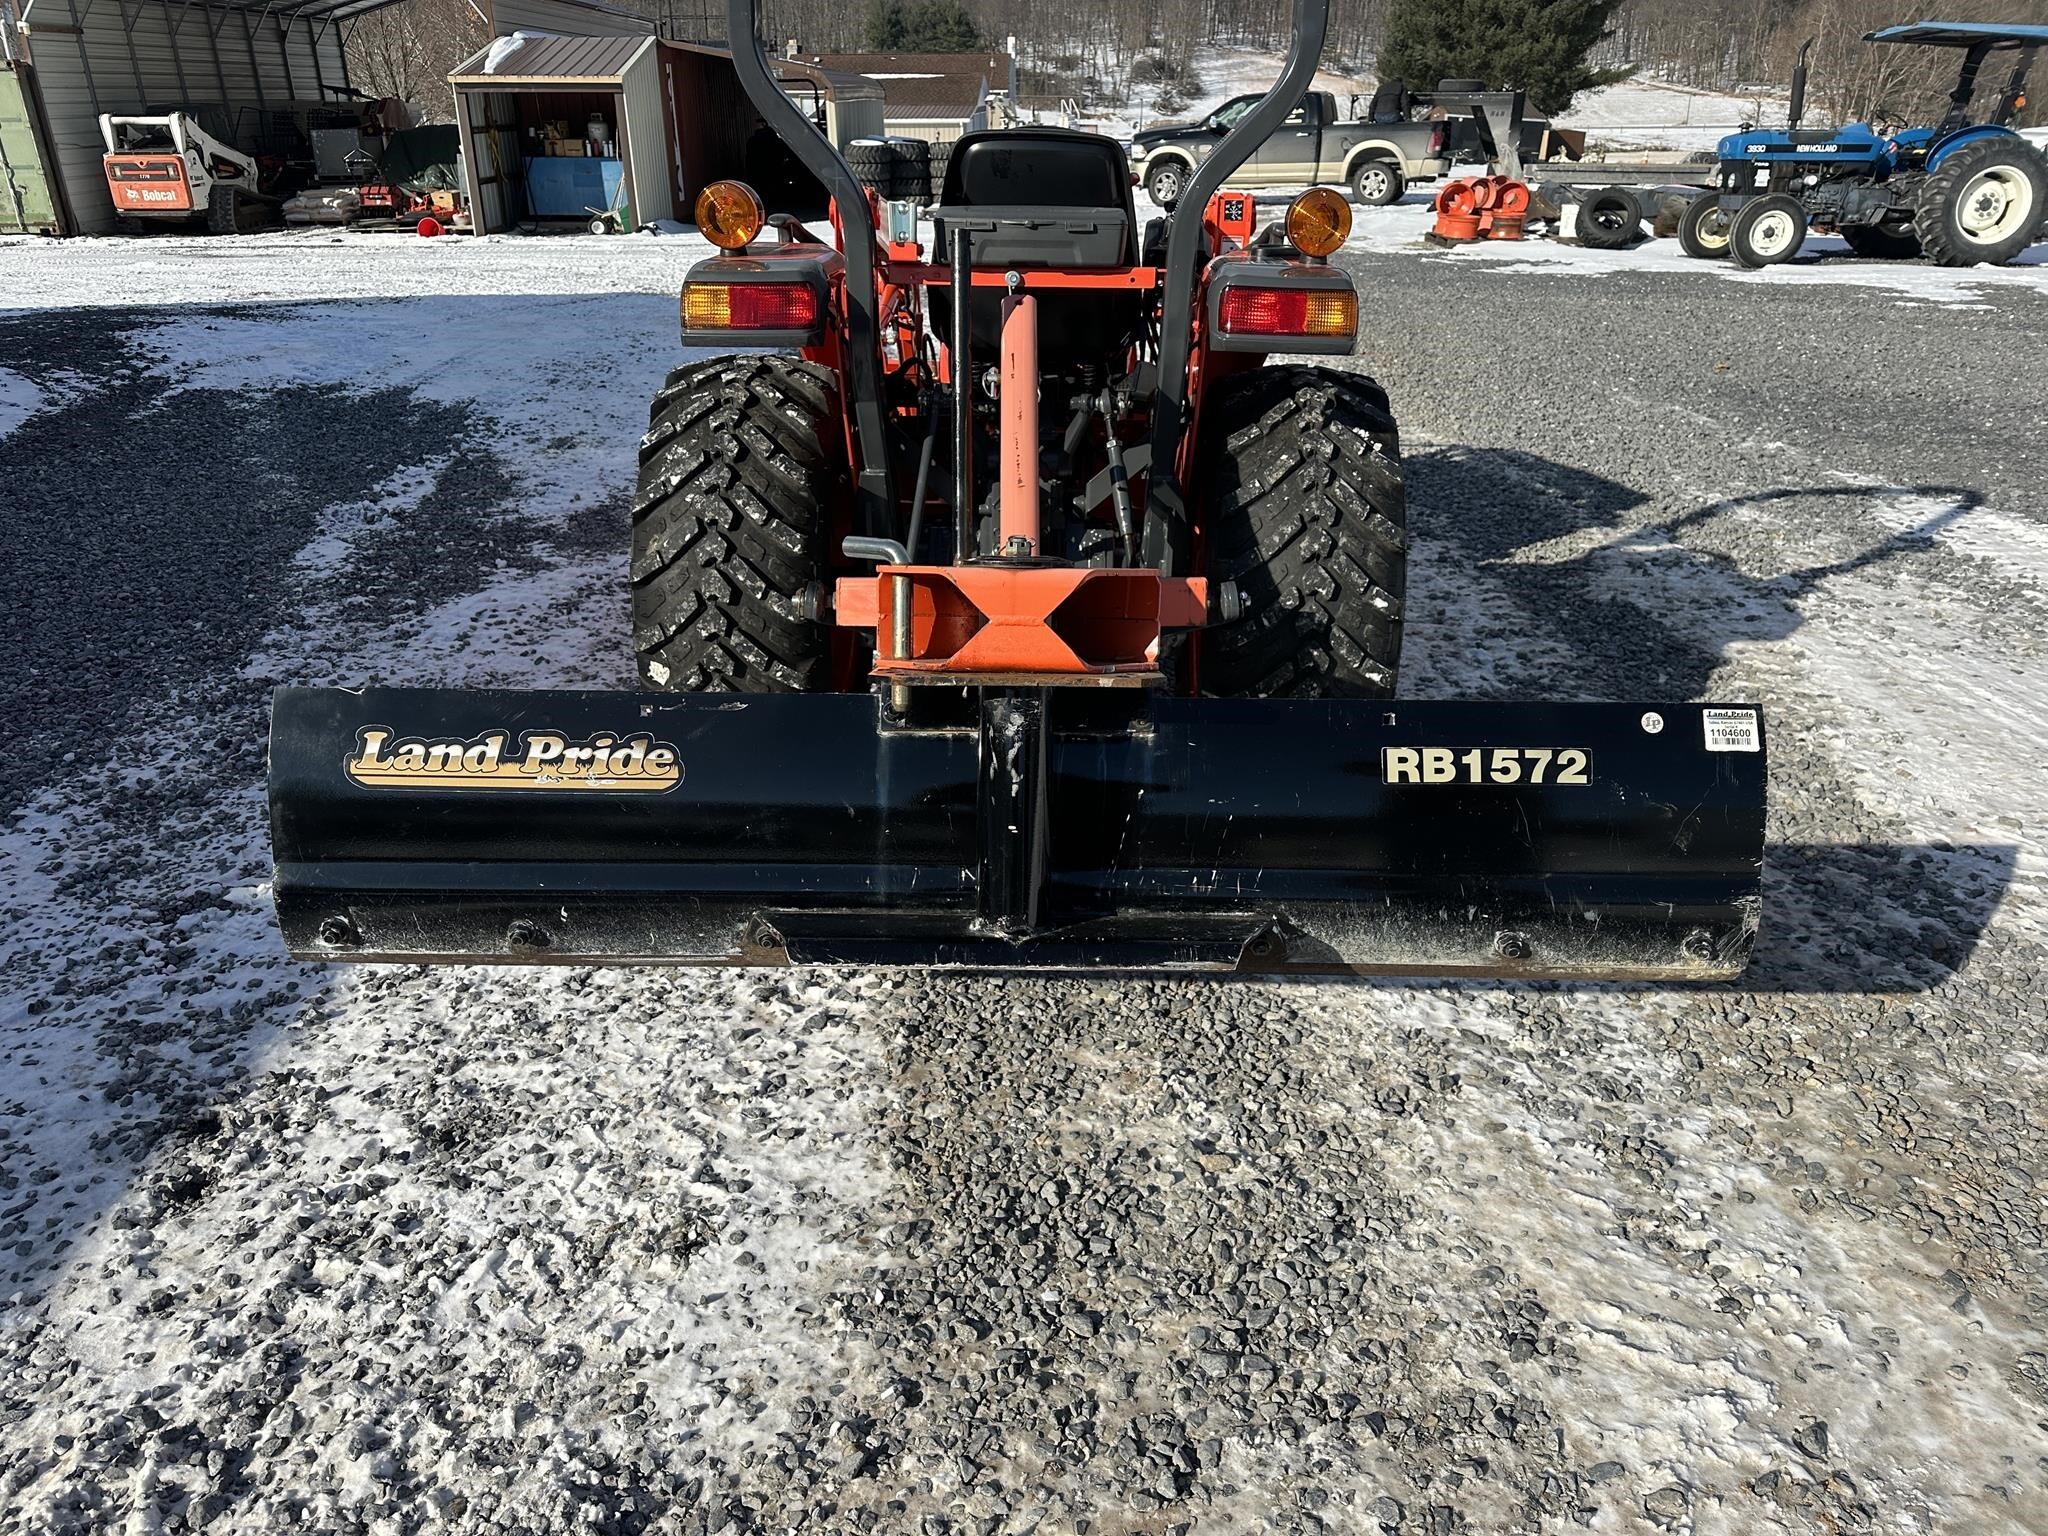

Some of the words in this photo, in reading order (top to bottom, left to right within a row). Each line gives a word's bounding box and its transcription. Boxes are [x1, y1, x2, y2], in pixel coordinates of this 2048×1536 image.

[1747, 144, 1766, 153] 3930
[1796, 144, 1810, 153] NEW
[1810, 144, 1838, 153] HOLLAND
[142, 189, 177, 201] Bobcat
[1710, 728, 1751, 738] 1104600
[355, 731, 504, 773] Land
[519, 735, 675, 776] Pride
[1386, 748, 1588, 784] RB1572
